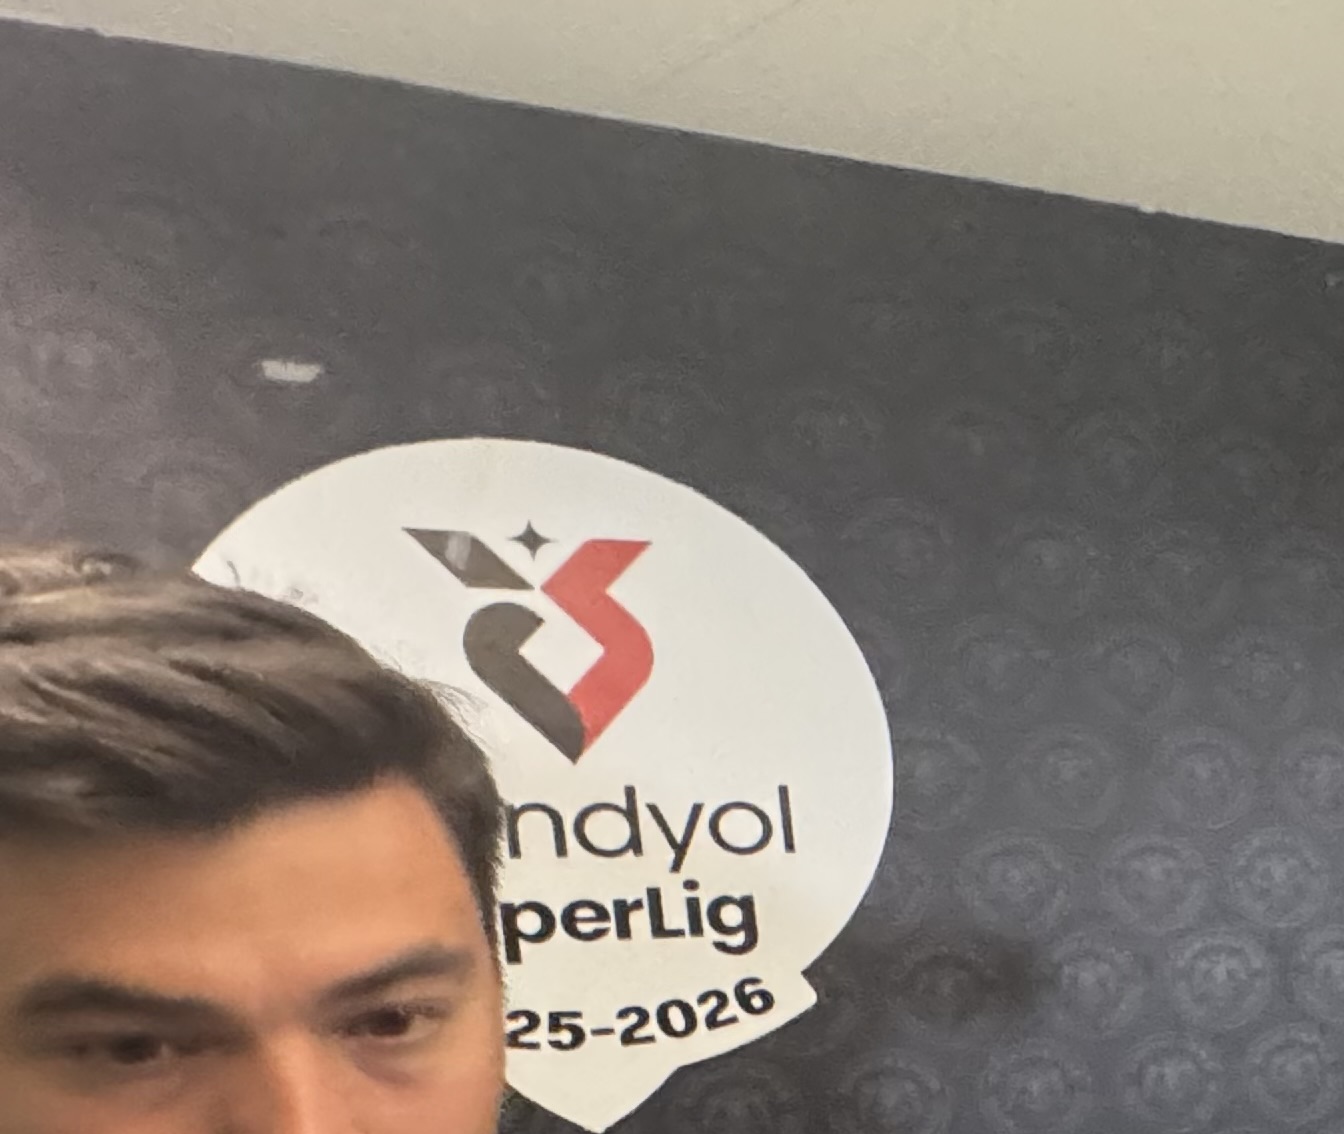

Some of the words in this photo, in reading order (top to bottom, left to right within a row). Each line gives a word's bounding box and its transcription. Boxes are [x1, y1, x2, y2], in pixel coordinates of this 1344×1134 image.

[504, 785, 796, 873] ndyol
[500, 879, 759, 965] perLig
[506, 977, 775, 1050] 25-2026
